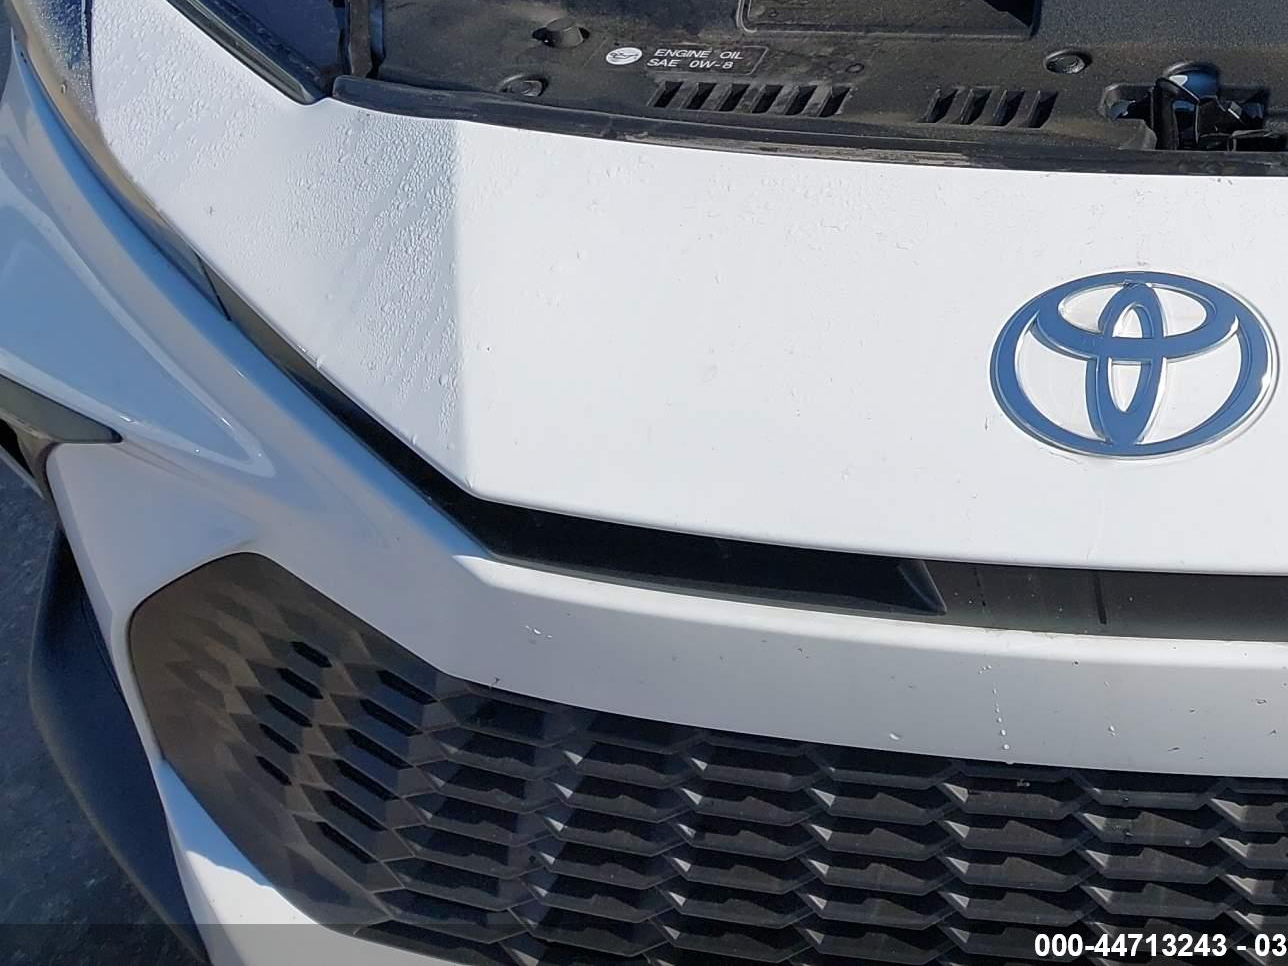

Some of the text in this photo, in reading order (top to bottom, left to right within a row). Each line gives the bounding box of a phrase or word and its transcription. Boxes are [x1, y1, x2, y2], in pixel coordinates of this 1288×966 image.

[654, 48, 744, 59] ENGINE OIL
[647, 58, 734, 69] SAE 0W-8
